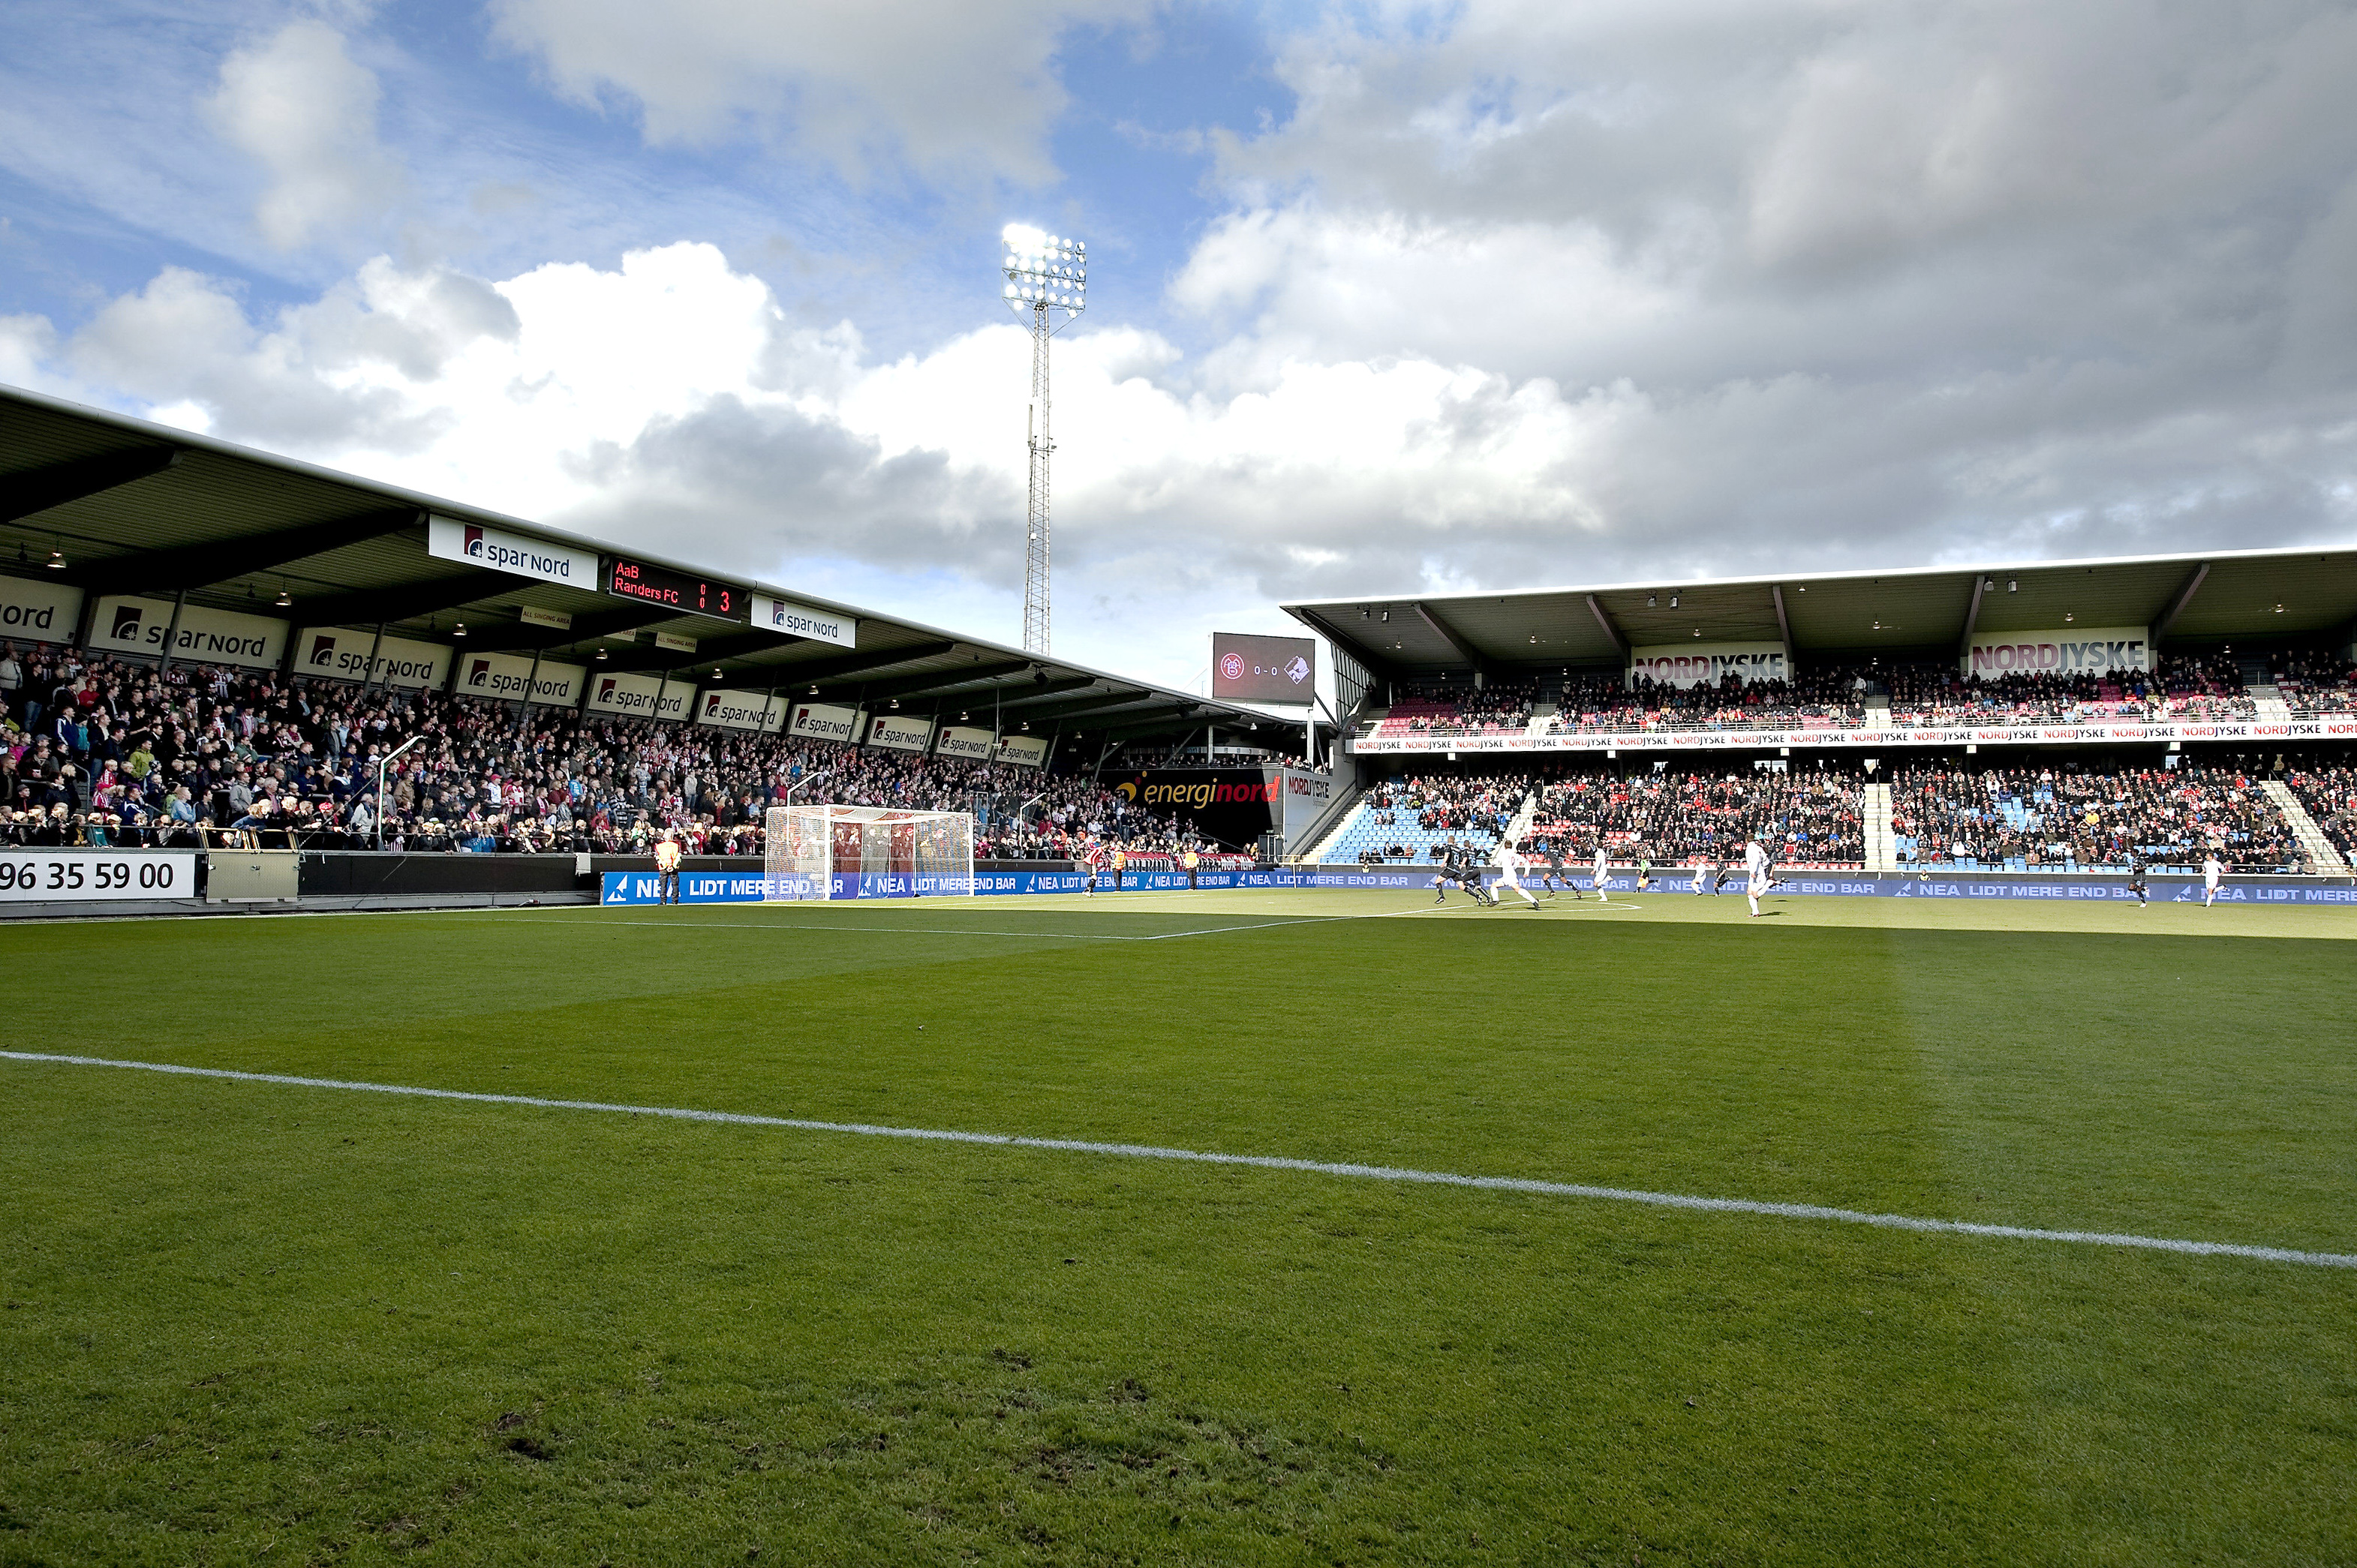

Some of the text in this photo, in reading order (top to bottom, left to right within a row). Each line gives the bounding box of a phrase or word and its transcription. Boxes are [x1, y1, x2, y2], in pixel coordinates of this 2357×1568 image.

[487, 544, 528, 567] spar
[615, 562, 639, 578] AaB
[615, 577, 678, 603] Randers FC
[699, 597, 705, 609] 0
[720, 591, 729, 612] 3
[0, 605, 55, 629] ord
[534, 613, 556, 622] SINGING
[786, 614, 813, 633] spar
[666, 638, 684, 646] SINGING
[337, 651, 387, 675] spar
[1973, 640, 2144, 672] NORDJYSKE
[1254, 665, 1261, 675] 0
[1271, 666, 1278, 676] 0
[1635, 653, 1784, 684] NORDJYSKE
[490, 673, 528, 694] spar
[615, 691, 651, 708] spar
[720, 706, 777, 725] spar Nod
[808, 718, 852, 735] spar Nor
[884, 729, 905, 743] spar
[1356, 724, 2357, 750] NORDJYSKE NORDJYSKE NORDJYSKE NORDJYSKE NORDJYSKE NORDJYSKE NORDJYSKE NORDJYSKE NORDJYSKE NORDJYSKE NORDJYSKE NORDJYSKE NORDJYSKE NORDJYSKE NORDJYSKE NORDJYSKE NOR
[949, 739, 969, 752] spar
[1007, 747, 1024, 760] spar
[1144, 776, 1280, 810] energinord
[1288, 776, 1330, 798] NORDJYSKE
[0, 862, 173, 890] 96 35 59 00
[1038, 876, 1138, 890] NEA LIDT ME EN BAR
[1155, 876, 1171, 887] NEA
[1174, 876, 1188, 886] LIDT
[1205, 876, 1218, 885] END
[1219, 876, 1231, 885] BAR
[1249, 875, 1408, 886] NEA LIDT MERE END BAR
[690, 879, 727, 896] LIDT
[731, 879, 775, 895] MERE
[780, 879, 810, 894] END
[815, 879, 844, 894] BR
[876, 877, 1016, 893] NEA LIDT MERE END BAR
[1766, 882, 1797, 893] ERE
[1801, 882, 1836, 893] END
[1841, 883, 1875, 894] BAR
[1920, 885, 1961, 896] NEA
[1969, 885, 2008, 896] LIDT
[2012, 886, 2064, 897] MERE
[2068, 887, 2106, 897] END
[2200, 888, 2357, 901] NEA LIDT MERE
